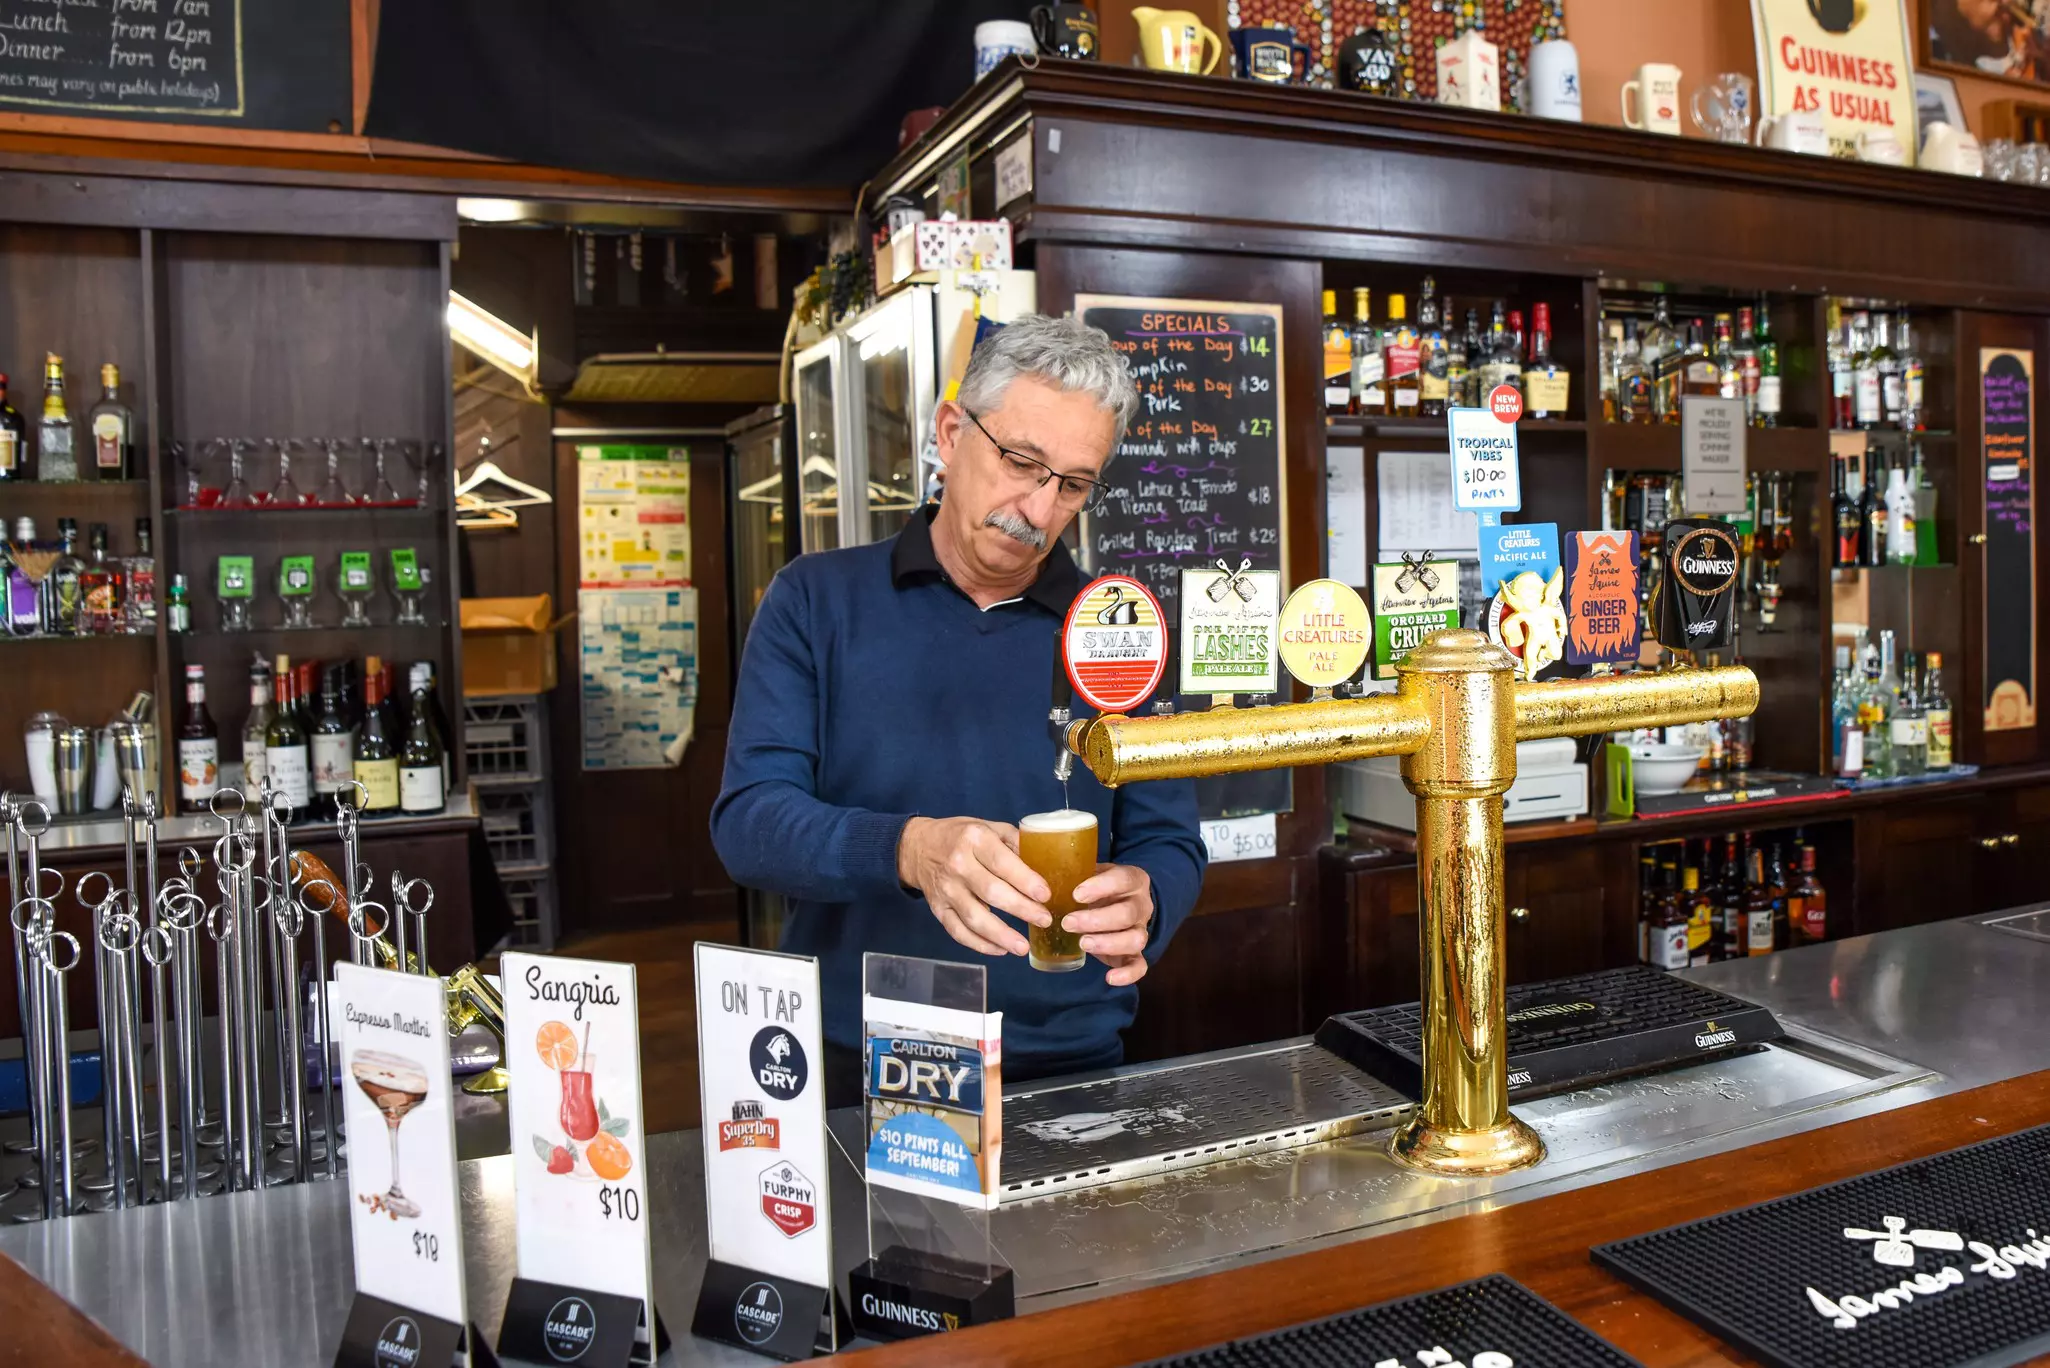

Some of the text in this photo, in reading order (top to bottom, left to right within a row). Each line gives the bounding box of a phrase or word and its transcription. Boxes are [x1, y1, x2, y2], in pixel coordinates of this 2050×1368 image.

[110, 16, 157, 41] from
[164, 19, 212, 51] 12pm
[108, 42, 155, 69] from
[168, 47, 208, 77] 6pm
[1779, 35, 1898, 91] GUINNESS
[27, 74, 59, 96] may
[62, 80, 96, 99] vary
[1792, 84, 1896, 128] AS USUAL
[1140, 312, 1231, 334] SPECIALS
[1111, 336, 1271, 363] oup of the Day $14
[1150, 378, 1165, 397] of
[1172, 378, 1197, 393] the
[1203, 378, 1233, 400] Day
[1239, 375, 1271, 396] $30
[1143, 393, 1183, 416] Pork
[1493, 404, 1520, 414] BREW
[1494, 394, 1517, 404] NEW
[1136, 420, 1153, 439] of
[1159, 420, 1184, 435] the
[1191, 420, 1218, 442] Day
[1238, 418, 1273, 438] $27
[1456, 437, 1514, 450] TROPICAL
[1470, 450, 1504, 462] VIBES
[1463, 467, 1507, 484] $10.00
[1471, 488, 1506, 501] PINTS
[1498, 535, 1541, 552] CREATURES
[1507, 529, 1532, 540] LITTLE
[1493, 550, 1547, 564] PACIFIC ALE
[1682, 556, 1734, 576] GUINNESS
[1588, 561, 1621, 578] James
[1588, 575, 1621, 591] Squire
[1581, 599, 1627, 618] GINGER
[1192, 624, 1270, 634] ONE FIFTY
[1302, 613, 1346, 628] LITTLE
[1389, 612, 1448, 627] ORCHARD
[1588, 617, 1621, 635] BEER
[1082, 630, 1154, 649] SWAN
[1192, 633, 1270, 661] LASHES
[1283, 629, 1365, 645] CREATURES
[1389, 623, 1448, 650] CRU
[1309, 650, 1339, 662] PALE
[1312, 662, 1335, 672] ALE
[525, 964, 621, 1022] Sangria
[720, 980, 803, 1024] ON TAP
[345, 1002, 431, 1039] Espresso Martini
[890, 1038, 958, 1061] CARLTON
[1694, 1030, 1736, 1048] GUINNESS
[759, 1068, 799, 1091] DRY
[765, 1063, 793, 1075] CARLTON
[877, 1054, 971, 1103] DRY
[731, 1103, 765, 1121] HAHN
[879, 1127, 969, 1161] $10 PINTS ALL
[886, 1146, 960, 1178] SEPTEMBER!
[763, 1180, 812, 1204] FURPHY
[598, 1184, 641, 1222] $10
[773, 1202, 803, 1220] CRISP
[1805, 1265, 1965, 1330] James
[737, 1303, 778, 1325] CASCADE
[861, 1292, 941, 1331] GUINNESS
[546, 1319, 590, 1340] CASCADE
[377, 1338, 416, 1363] CASCADE
